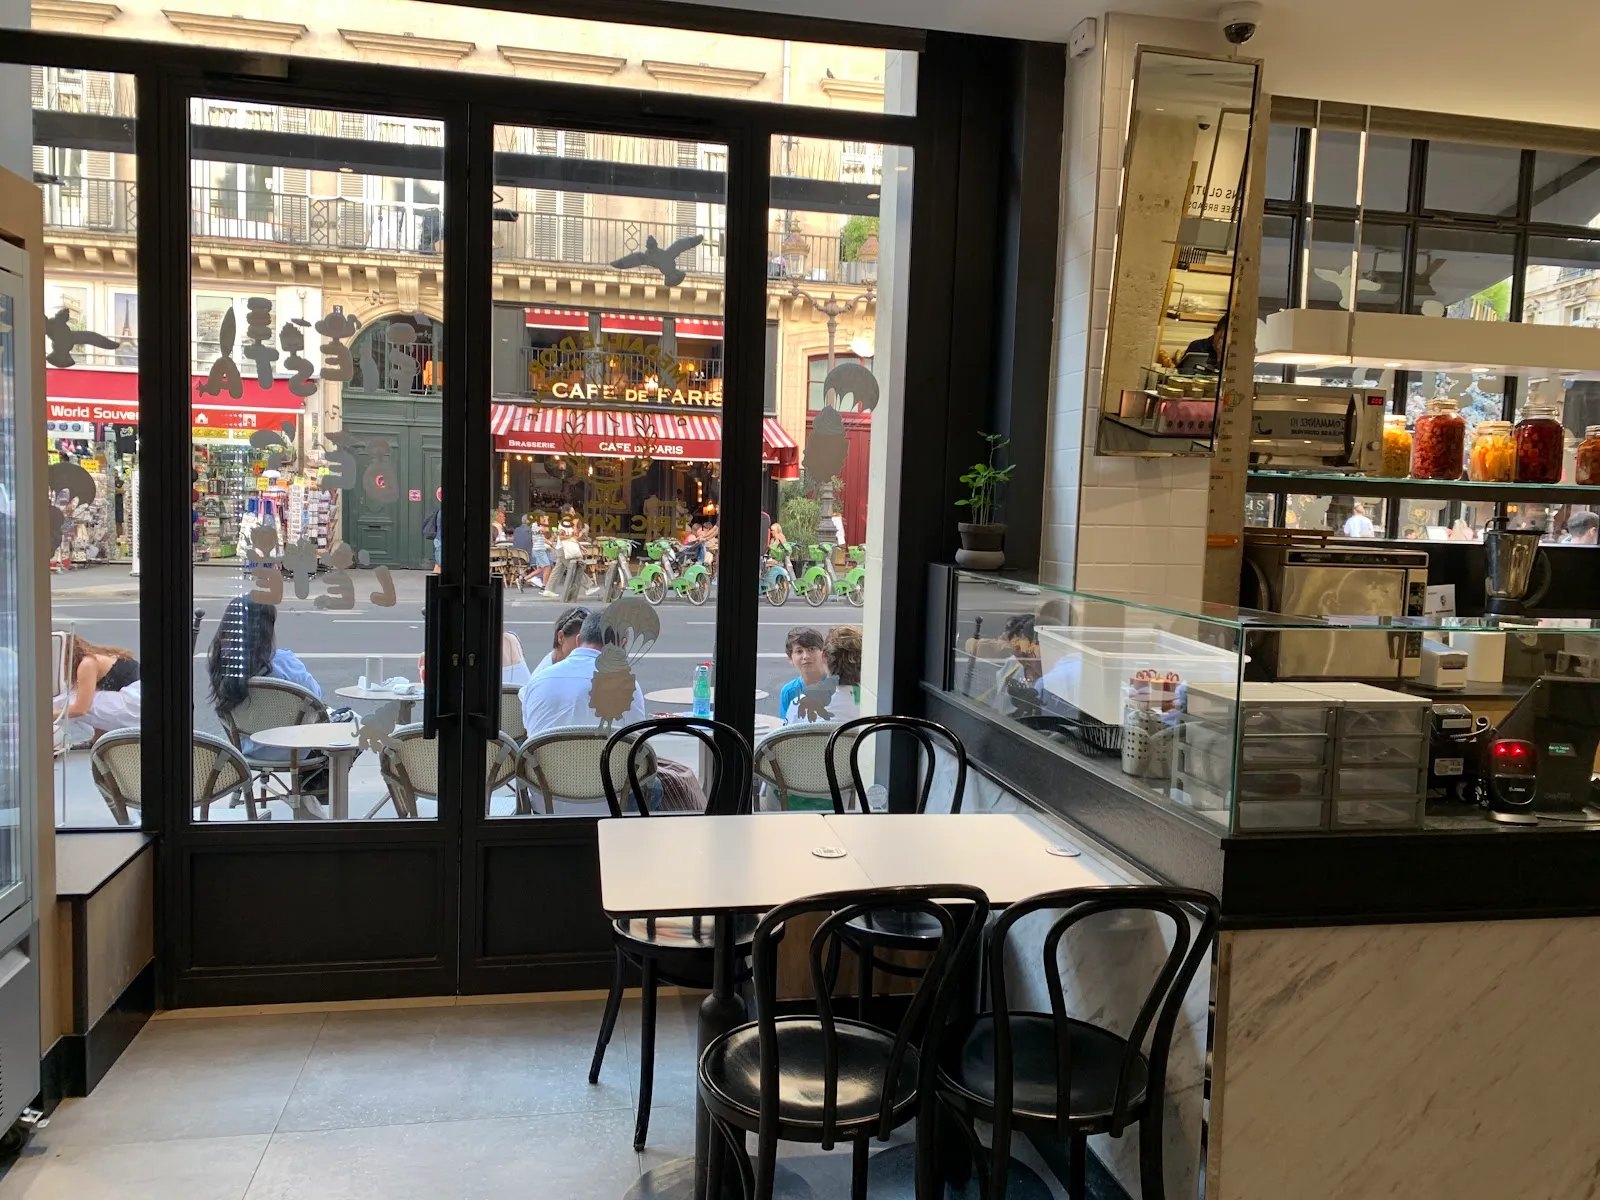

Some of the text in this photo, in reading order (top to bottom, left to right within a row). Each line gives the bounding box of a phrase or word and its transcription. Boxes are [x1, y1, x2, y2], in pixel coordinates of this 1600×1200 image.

[552, 382, 722, 407] CAFE DE PARIS
[50, 405, 90, 418] World
[508, 439, 556, 449] BRASSERIE
[599, 442, 632, 453] CAFE
[649, 444, 684, 455] PARIS
